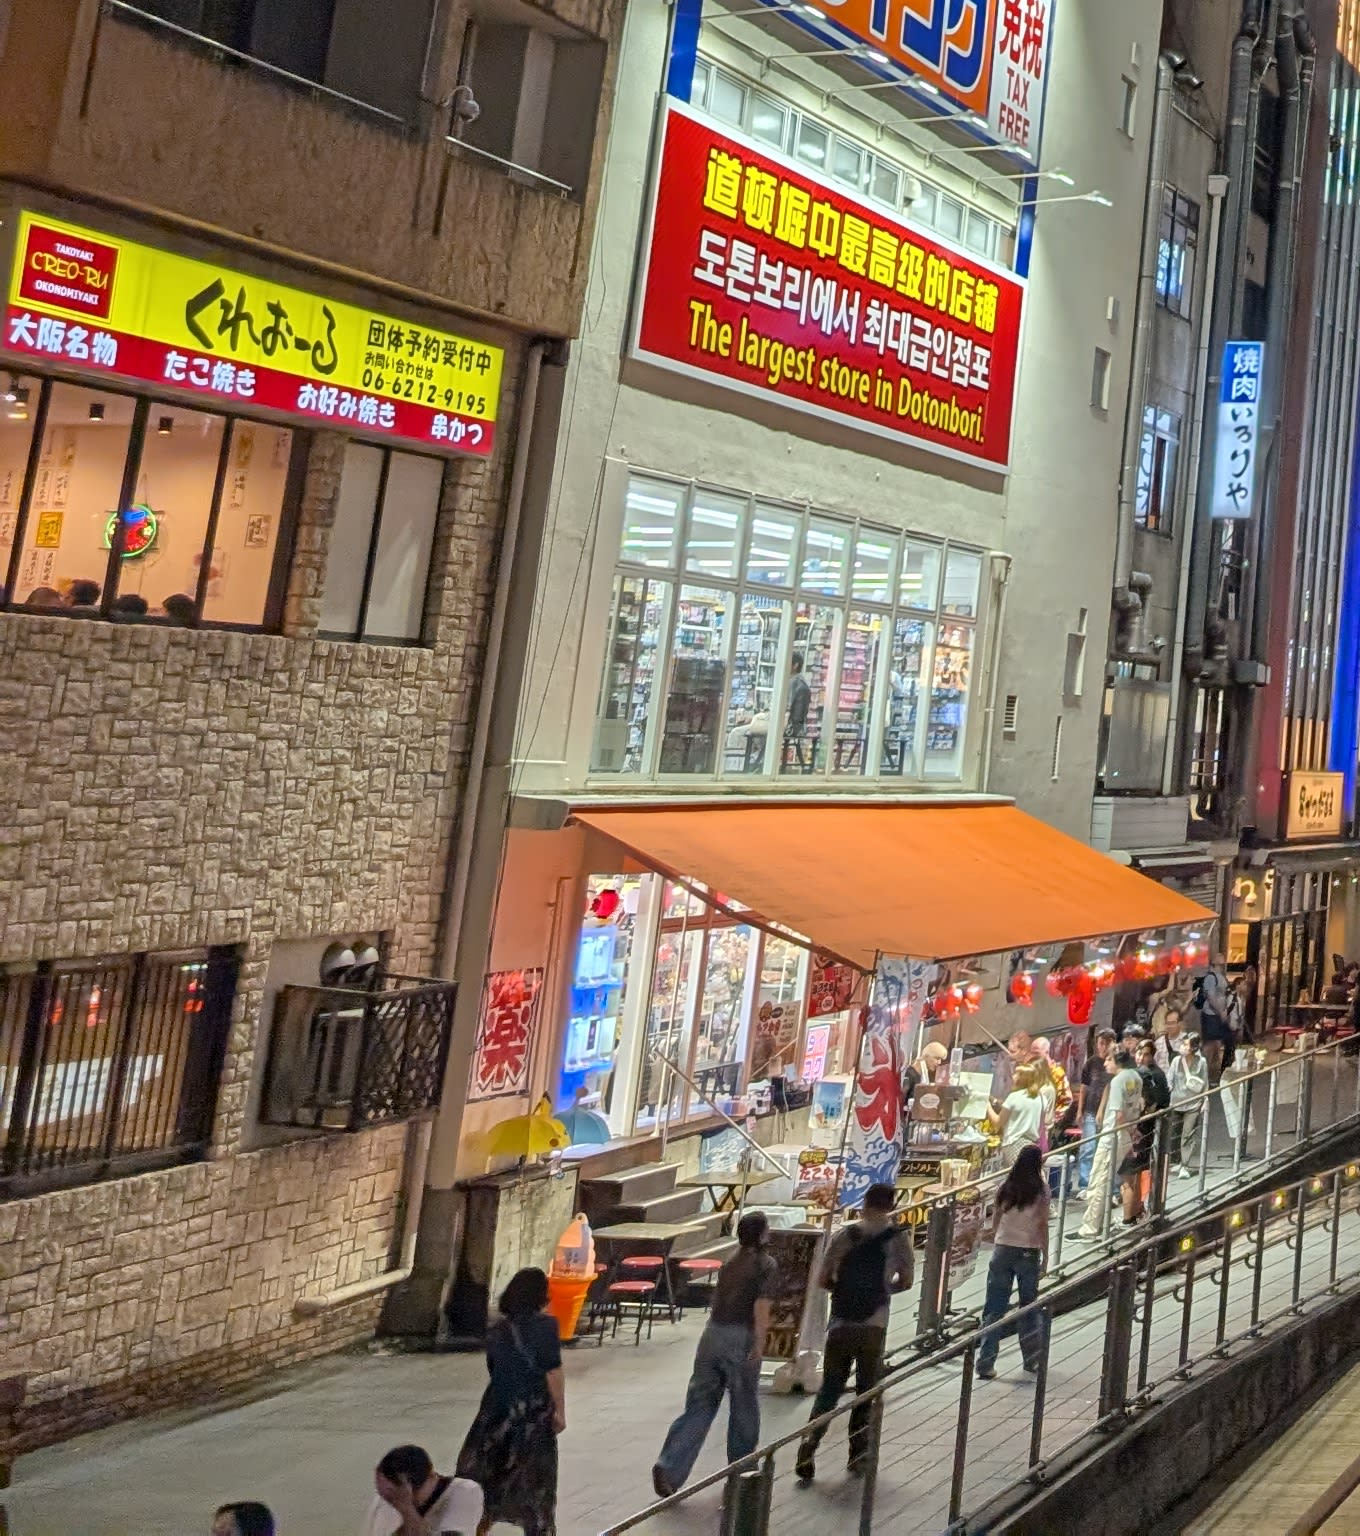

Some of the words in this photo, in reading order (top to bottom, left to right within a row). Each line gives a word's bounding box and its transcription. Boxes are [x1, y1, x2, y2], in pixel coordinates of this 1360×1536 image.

[1005, 67, 1030, 112] TAX
[998, 103, 1031, 148] FREE
[31, 251, 109, 290] CREO-RU
[54, 242, 95, 262] TAKOYAKI
[34, 279, 99, 306] OKONOMIYAKI
[693, 229, 860, 345] 도톤보리에서
[862, 299, 992, 391] 최대급인점포
[185, 277, 339, 375] くれおーる
[367, 319, 492, 377] 団体予約受付中
[9, 312, 118, 369] 大阪名物
[163, 349, 257, 399] たこ焼き
[297, 381, 396, 429] お好み焼き
[431, 413, 484, 446] 串かつ
[364, 351, 434, 381] お問い合わせは
[689, 300, 733, 358] The
[737, 317, 816, 386] largest
[819, 352, 870, 404] store
[875, 369, 893, 413] in
[897, 378, 986, 444] Dotonbori.
[1232, 347, 1260, 402] 焼肉
[362, 368, 486, 416] 06-6212-9195
[1225, 405, 1253, 510] いろりや
